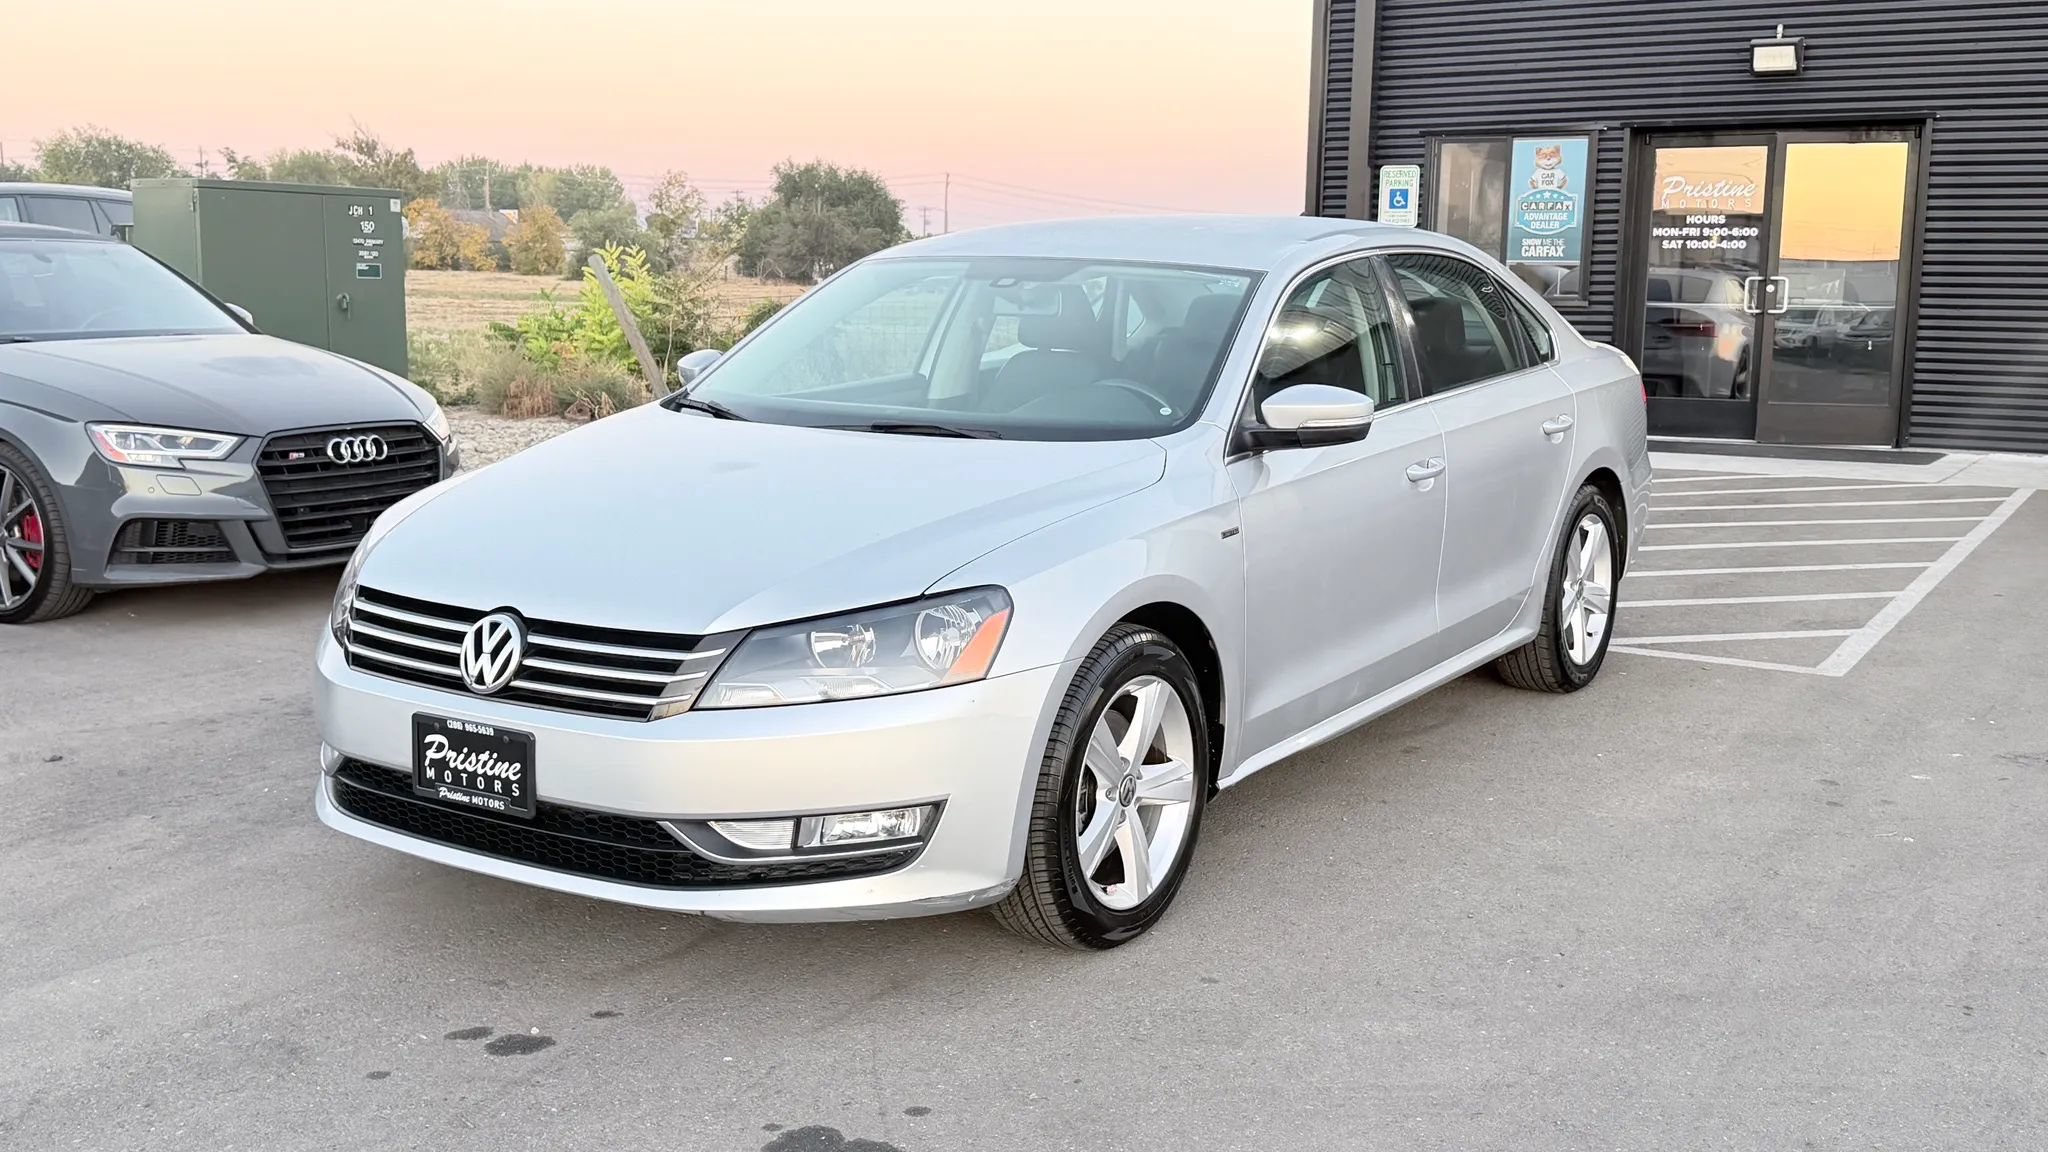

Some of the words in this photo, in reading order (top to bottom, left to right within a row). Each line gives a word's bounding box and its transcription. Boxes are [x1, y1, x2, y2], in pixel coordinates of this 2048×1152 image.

[1383, 170, 1416, 178] RESERVED
[1385, 179, 1413, 187] PARKING
[1661, 176, 1757, 200] Pristine
[1521, 202, 1572, 210] CARFAX
[1661, 199, 1752, 209] MOTORS
[368, 206, 373, 216] 1
[1524, 212, 1568, 220] ADVANTAGE
[1686, 215, 1726, 224] HOURS
[360, 221, 375, 231] 150
[1530, 221, 1560, 229] DEALER
[1652, 227, 1700, 236] MON-FRI
[1702, 227, 1759, 236] 9:00-6:00
[1661, 240, 1684, 249] SAT
[1686, 240, 1747, 249] 10:00-4:00
[1521, 246, 1565, 257] CARFAX
[423, 733, 522, 781] Pristine
[425, 766, 520, 797] MOTORS
[437, 786, 470, 803] Pristine
[471, 795, 505, 810] MOTORS
